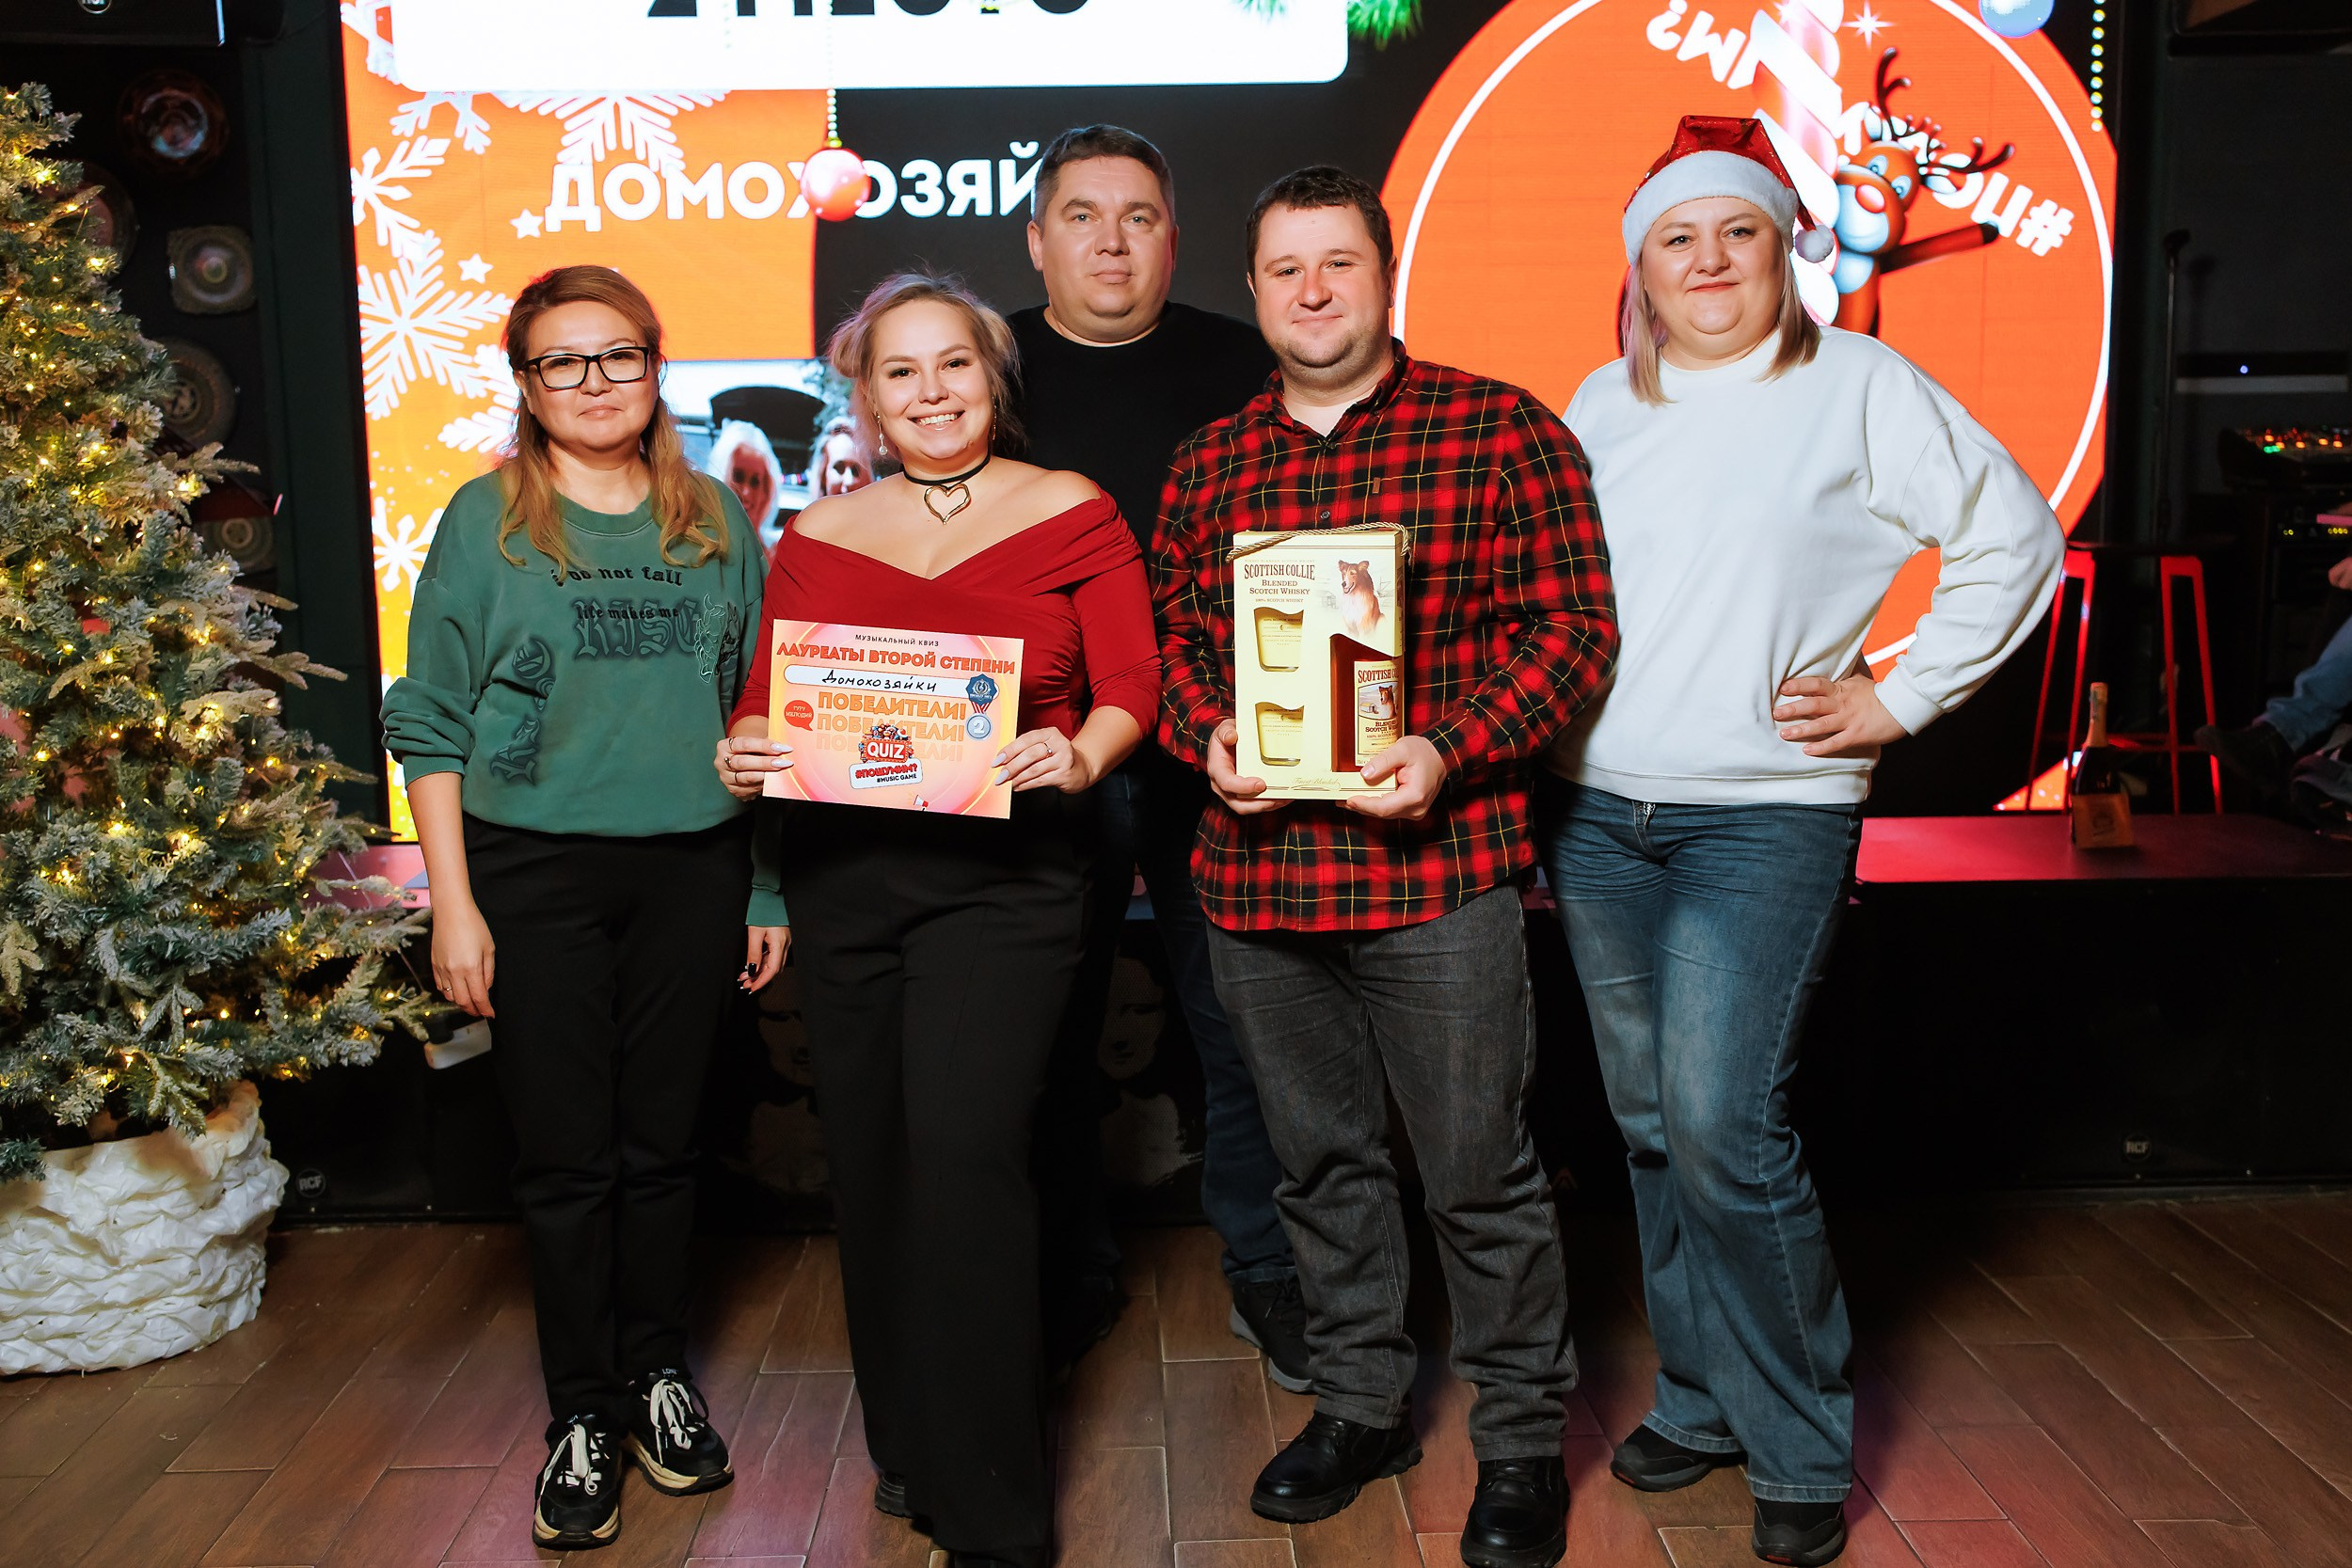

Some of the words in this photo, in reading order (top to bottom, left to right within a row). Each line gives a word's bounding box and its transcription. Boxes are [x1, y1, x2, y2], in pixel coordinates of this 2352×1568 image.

[597, 567, 634, 579] not
[641, 566, 682, 586] fall
[1244, 563, 1284, 579] SCOTTISH
[1285, 563, 1315, 580] COLLIE
[1280, 587, 1311, 595] WHISKY
[576, 604, 603, 620] life
[608, 606, 655, 620] makes
[659, 607, 679, 618] me
[855, 634, 915, 645] МУЗЫКАЛЬНЫЙ
[776, 641, 865, 662] ЛАУРЕАТЫ
[868, 649, 936, 668] ВТОРОЙ
[940, 656, 1015, 674] СТЕПЕНИ
[821, 669, 937, 692] Домохозяйки
[1358, 669, 1391, 684] SCOTTISH
[818, 691, 966, 720] ПОБЕДИТЕЛИ!
[973, 719, 985, 734] 2
[866, 741, 905, 758] QUIZ
[299, 1176, 321, 1190] RCF
